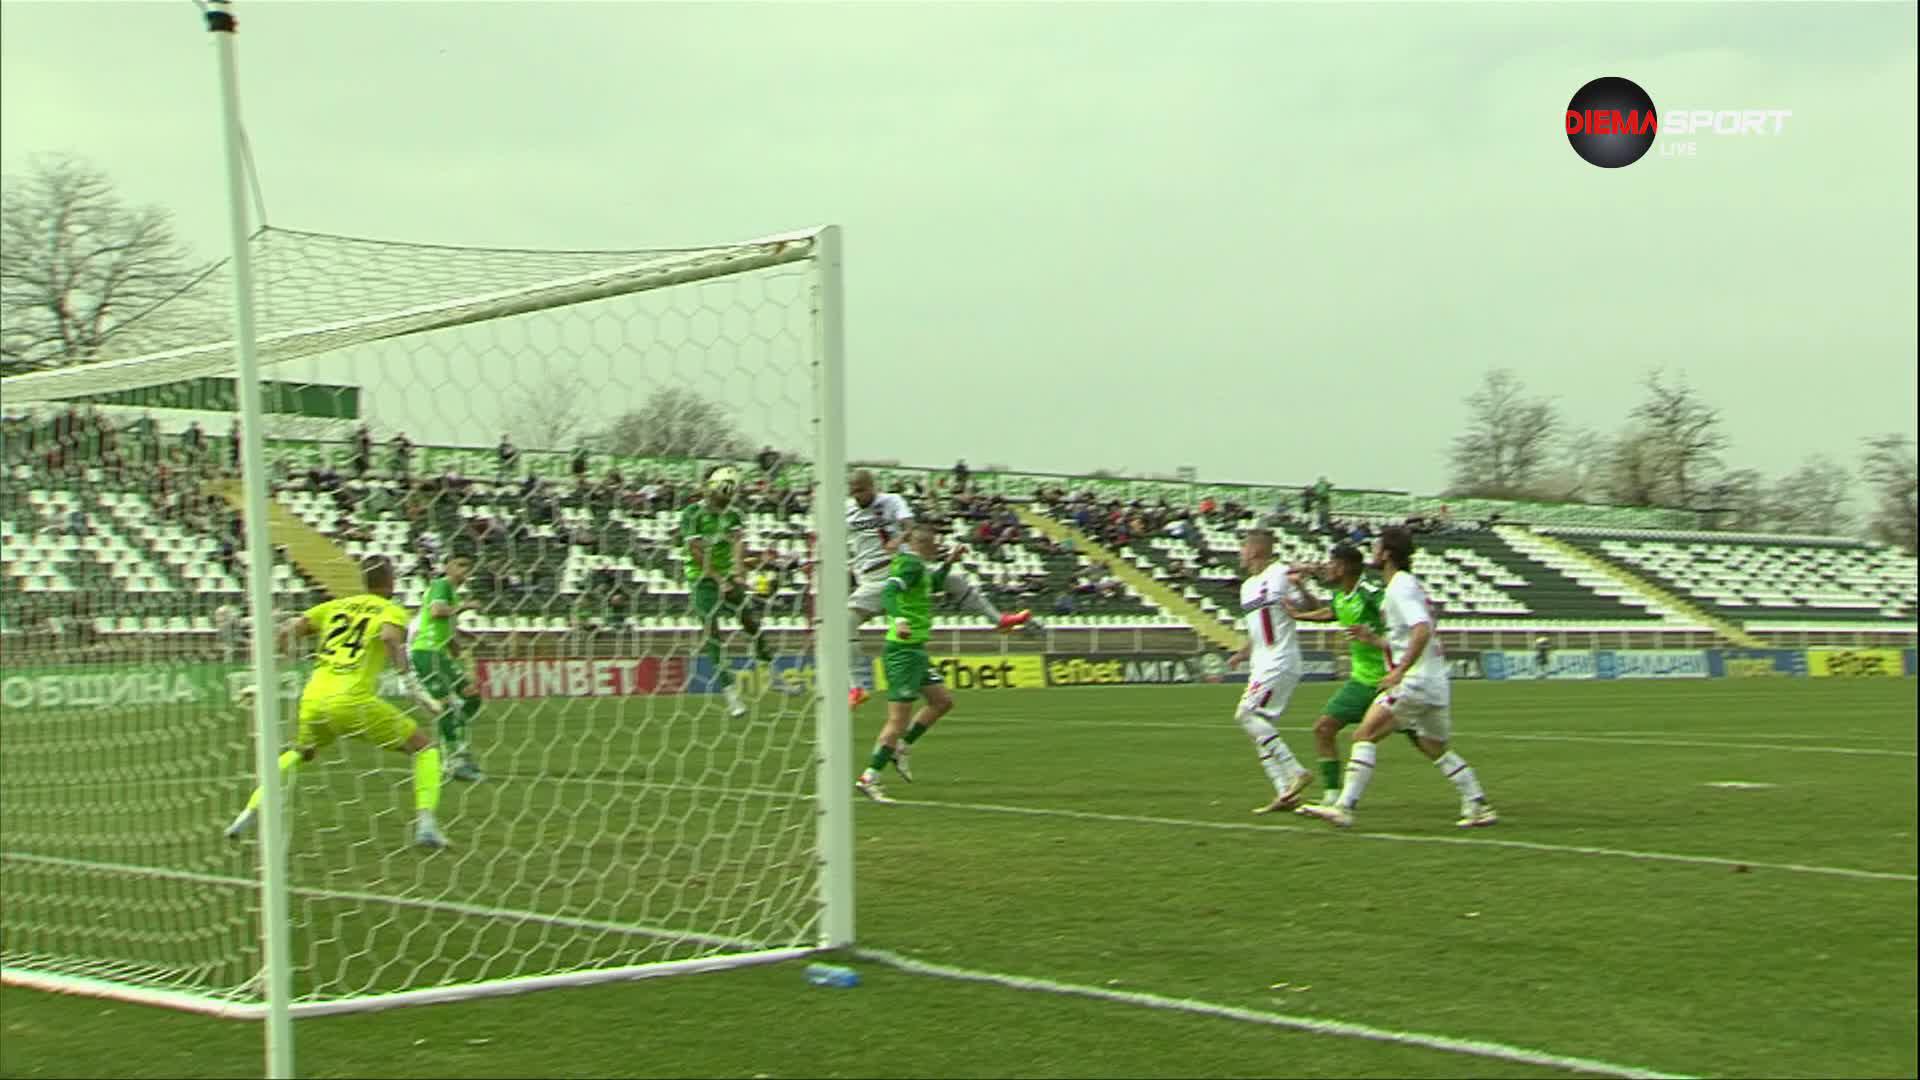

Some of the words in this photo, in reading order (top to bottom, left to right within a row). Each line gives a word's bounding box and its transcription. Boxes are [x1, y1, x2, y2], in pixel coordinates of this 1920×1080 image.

[320, 612, 371, 659] 24
[4, 673, 196, 709] ОБЩИНА
[484, 660, 643, 697] WINBET
